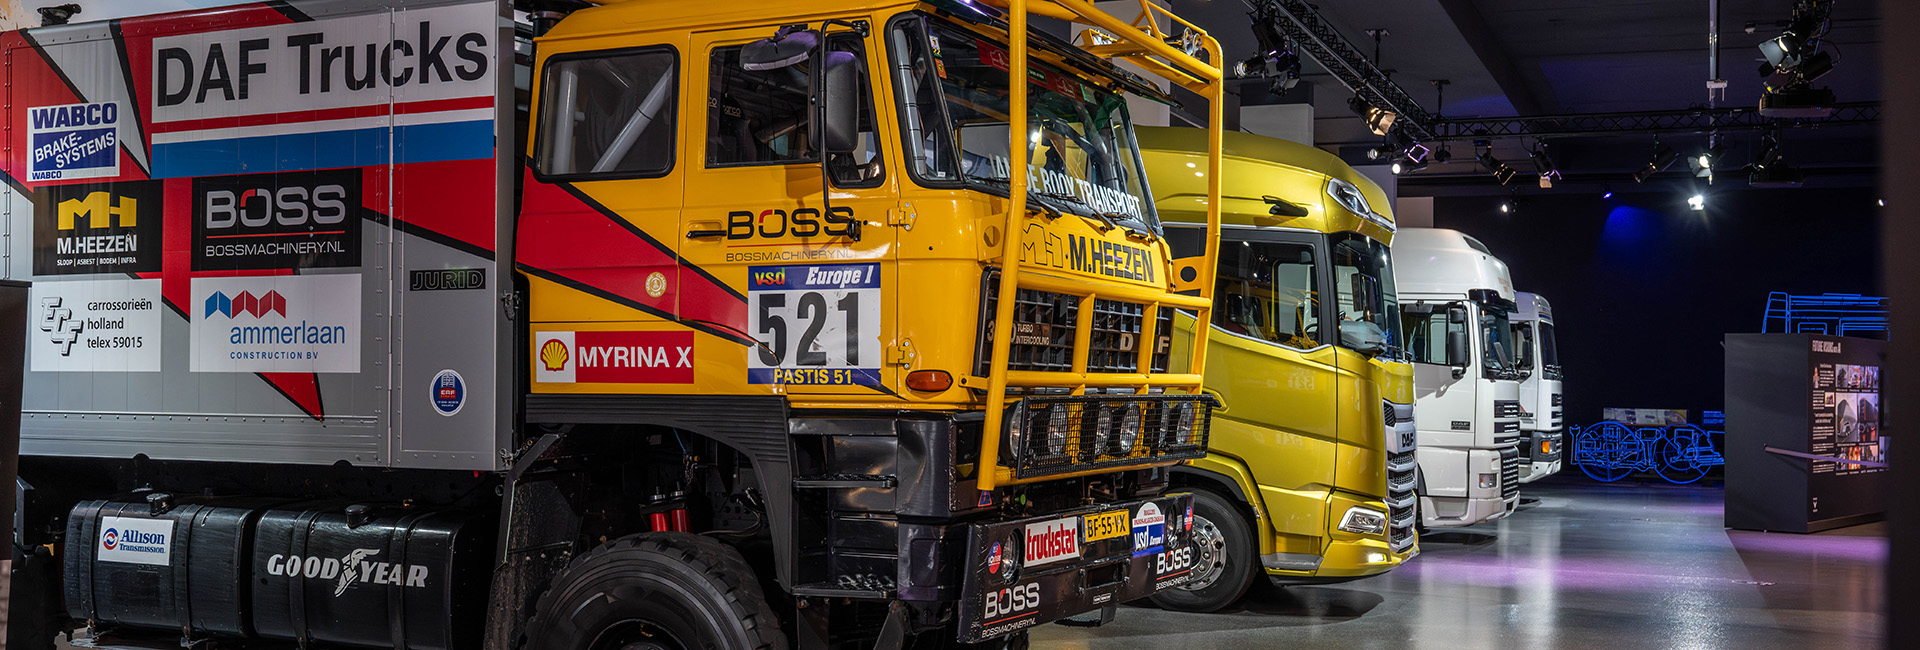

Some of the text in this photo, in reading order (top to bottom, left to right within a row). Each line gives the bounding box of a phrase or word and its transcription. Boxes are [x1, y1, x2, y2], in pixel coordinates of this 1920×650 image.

[157, 21, 488, 107] DAF Trucks
[32, 102, 117, 129] WABCO
[35, 133, 83, 163] BRAKE-
[55, 131, 115, 168] SYSTEMS
[32, 171, 62, 180] WABCO
[1040, 167, 1074, 196] ROOY
[1076, 178, 1144, 223] TRANSPORT
[58, 191, 137, 230] MH
[206, 184, 346, 229] BOSS
[727, 206, 856, 240] BOSS
[56, 234, 137, 254] M.HEEZEN
[205, 240, 346, 257] BOSSMACHINERY.NL
[1068, 233, 1155, 283] M.HEEZEN
[412, 269, 484, 290] JURID
[805, 266, 862, 288] Europe
[87, 298, 152, 311] carrossorieën
[87, 318, 124, 330] holland
[230, 320, 346, 345] ammerlaan
[757, 291, 860, 367] 521
[1017, 323, 1034, 333] TURBO
[87, 336, 143, 349] telex 59015
[1016, 335, 1050, 346] INTERCOOLING
[230, 351, 319, 360] CONSTRUCTION BV
[578, 346, 692, 368] MYRINA X
[773, 369, 852, 384] PASTIS 51
[1402, 432, 1414, 447] DAF
[120, 529, 165, 545] Allison
[1087, 515, 1126, 538] BF-55-VX
[119, 543, 165, 554] Transmission
[1026, 522, 1076, 561] truckstar
[1156, 546, 1191, 575] BOSS
[984, 582, 1040, 619] BOSS
